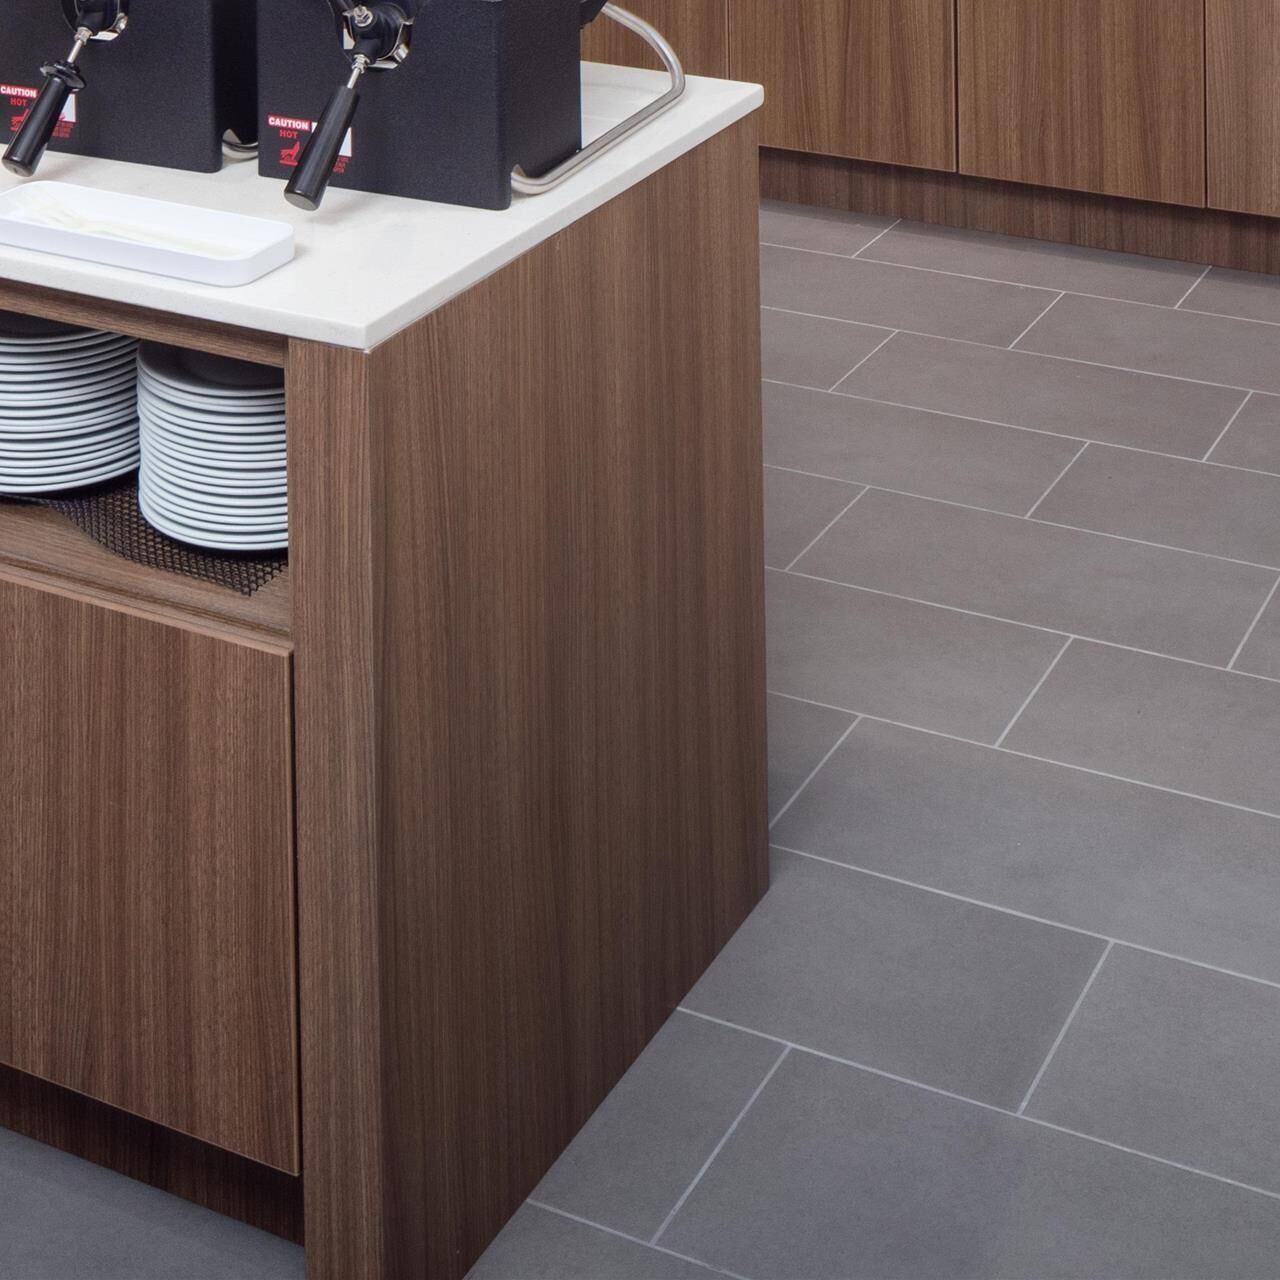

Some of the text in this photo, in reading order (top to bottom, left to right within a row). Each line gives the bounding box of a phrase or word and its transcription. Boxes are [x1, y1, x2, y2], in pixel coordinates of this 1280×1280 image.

[0, 86, 37, 98] CAUTION
[10, 97, 28, 106] HOT
[267, 116, 310, 131] CAUTION
[279, 128, 298, 139] HOT
